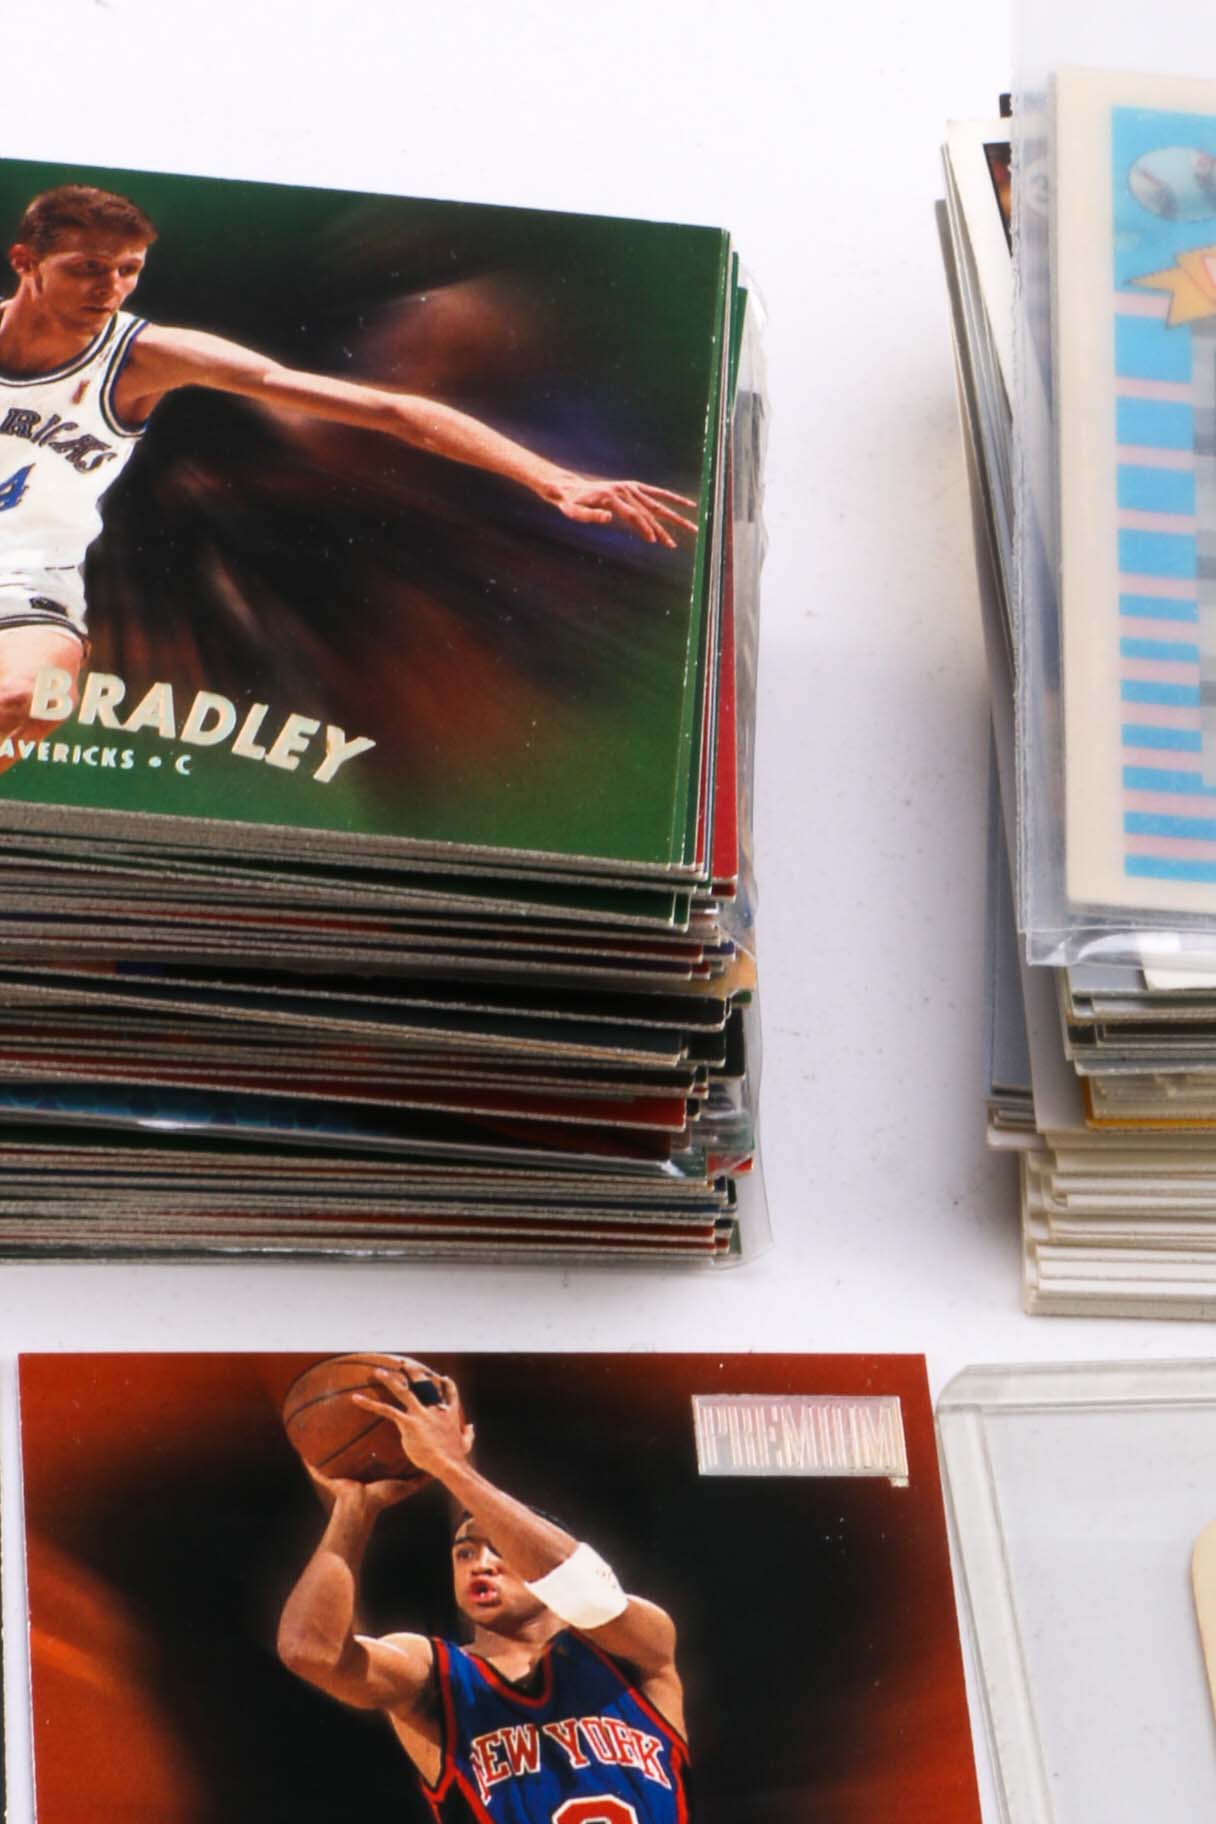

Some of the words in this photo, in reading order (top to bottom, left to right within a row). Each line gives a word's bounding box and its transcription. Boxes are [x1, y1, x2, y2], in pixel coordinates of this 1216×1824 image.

[29, 665, 378, 784] BRADLEY
[174, 754, 193, 776] C
[542, 1715, 673, 1791] YORK
